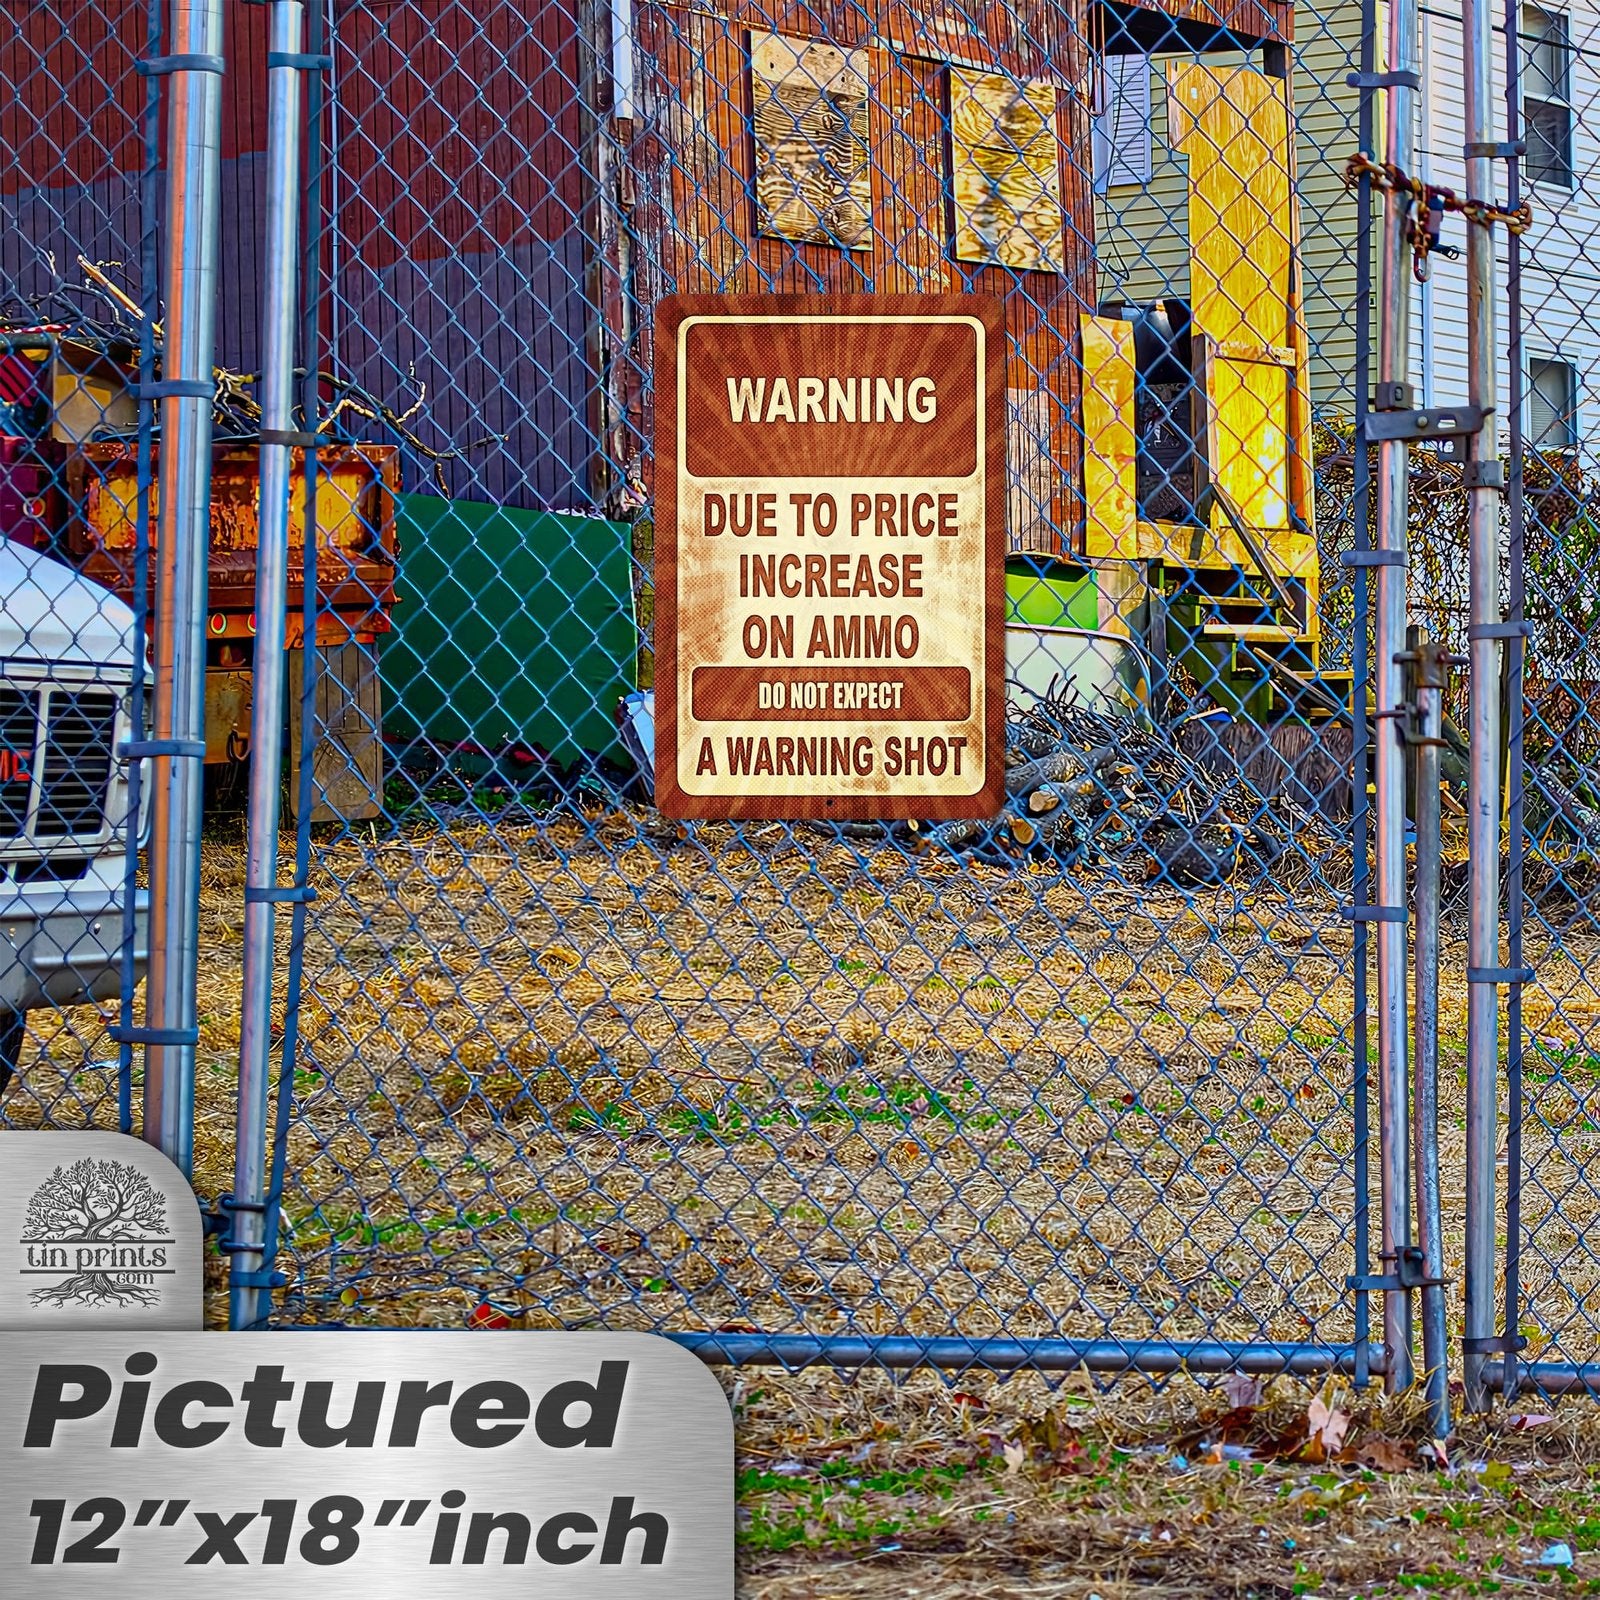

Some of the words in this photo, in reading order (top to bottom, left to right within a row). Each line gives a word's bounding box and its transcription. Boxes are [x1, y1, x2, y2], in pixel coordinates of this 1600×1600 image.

[726, 376, 938, 424] WARNING
[703, 493, 777, 537] DUE
[789, 493, 838, 537] TO
[850, 493, 959, 537] PRICE
[739, 554, 924, 598] INCREASE
[742, 615, 794, 659] ON
[806, 615, 920, 659] AMMO
[758, 682, 788, 709] DO
[790, 682, 831, 709] NOT
[833, 682, 904, 709] EXPECT
[695, 736, 716, 776] A
[726, 736, 874, 777] WARNING
[883, 736, 967, 777] SHOT
